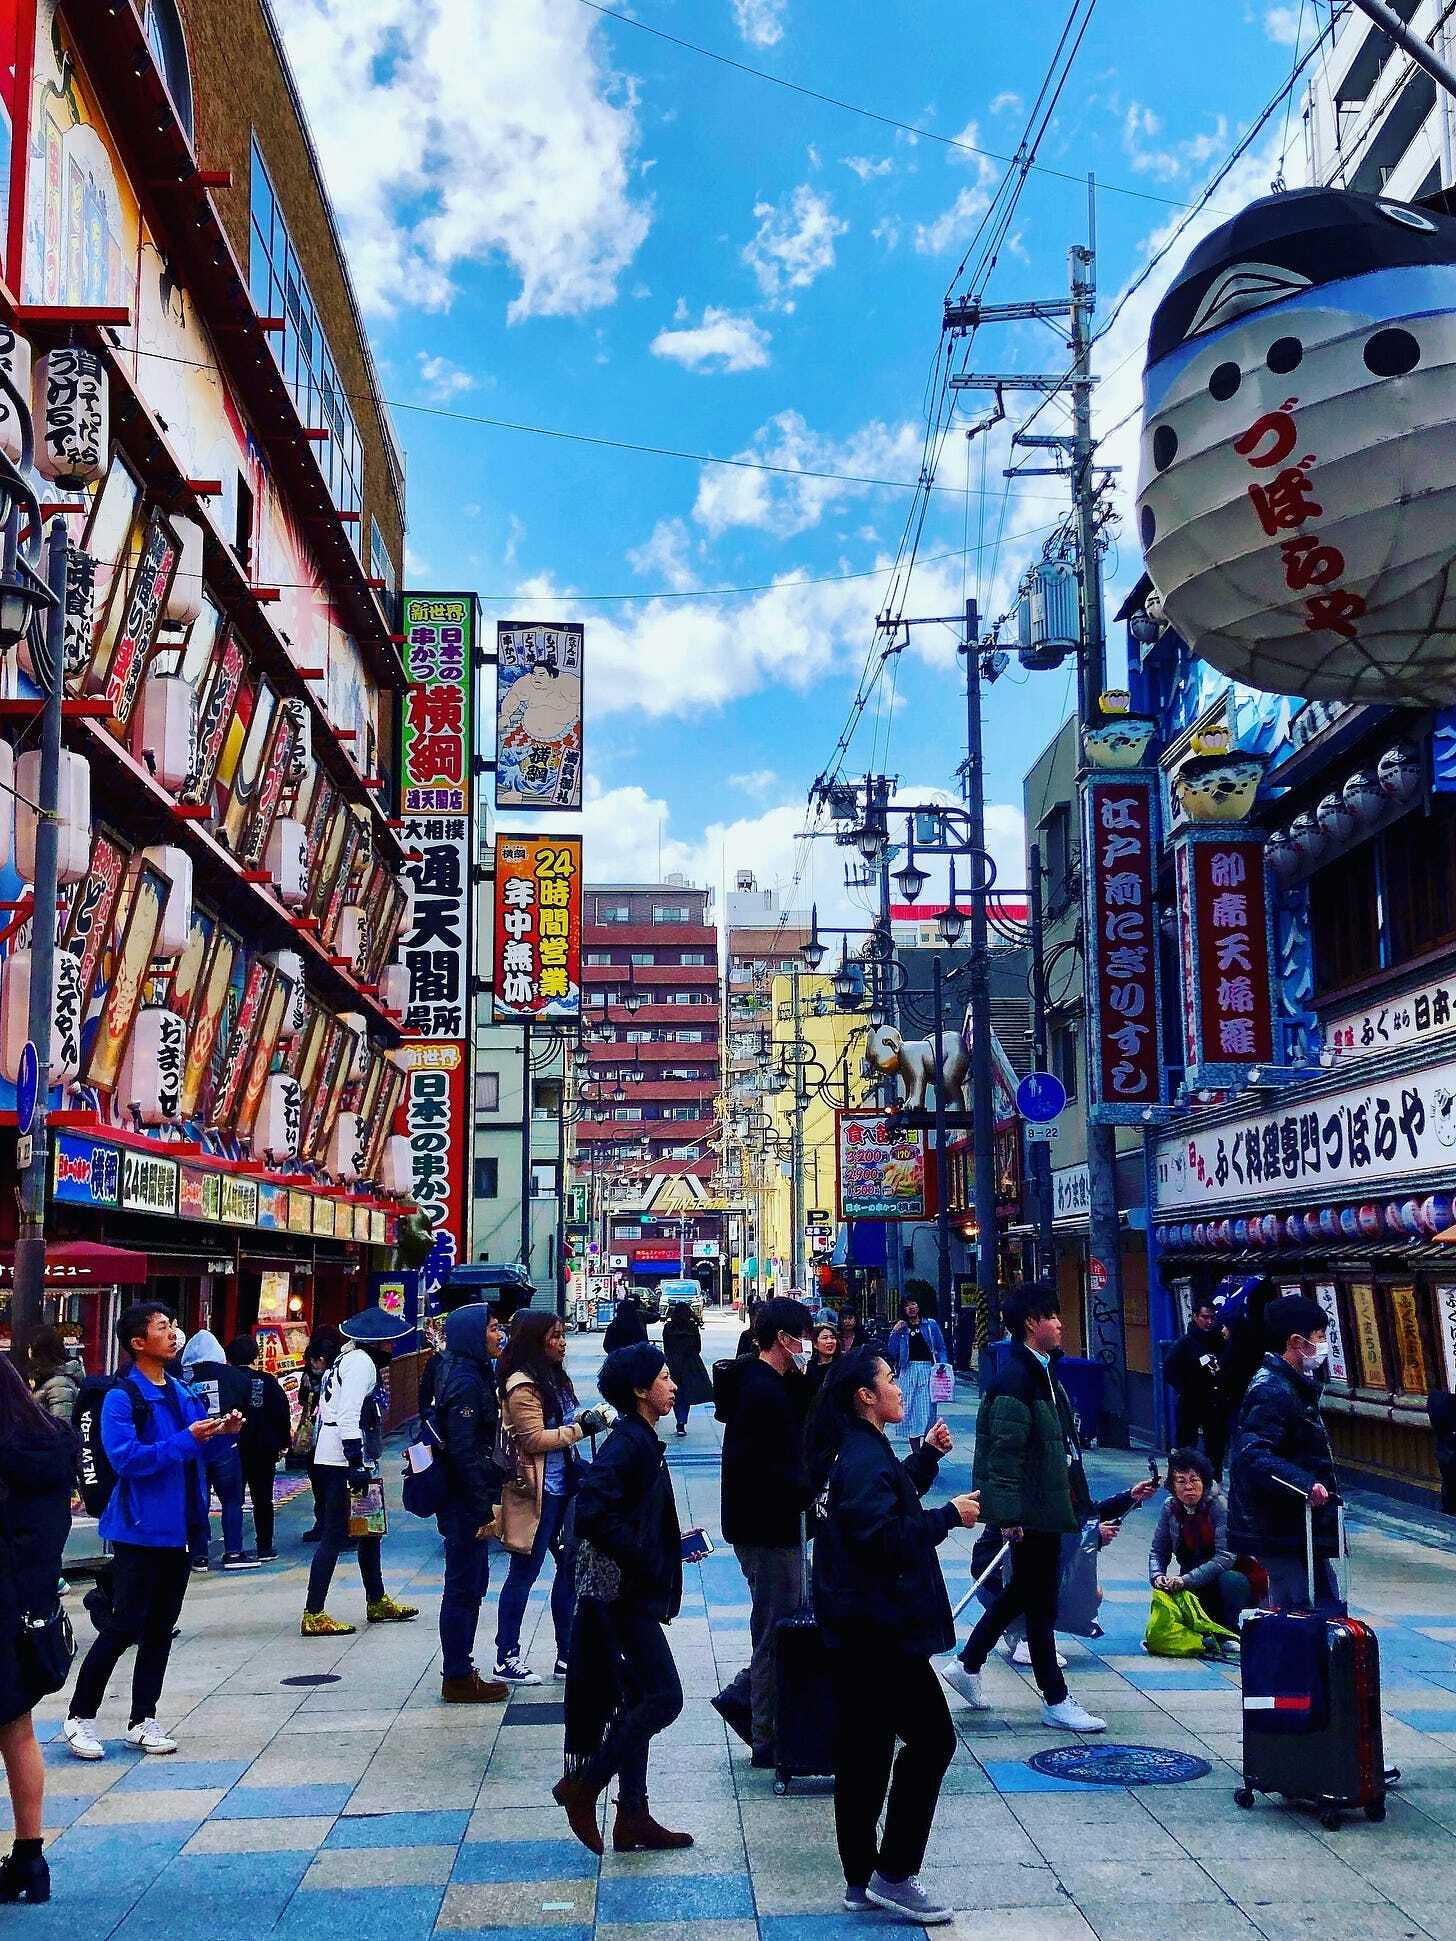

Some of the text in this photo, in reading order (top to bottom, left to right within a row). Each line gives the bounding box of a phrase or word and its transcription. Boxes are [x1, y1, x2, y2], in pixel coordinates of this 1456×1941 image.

[1234, 398, 1367, 637] づぼらや
[410, 602, 465, 622] 新世界
[409, 627, 437, 681] 串かつ
[438, 627, 464, 682] 日本一の
[407, 684, 464, 784] 横綱
[406, 788, 463, 811] 通天閣店
[404, 819, 465, 841] 大相撲
[401, 845, 464, 1003] 通天閣
[504, 878, 535, 1004] 年中無休
[536, 848, 575, 997] 24時間営業
[1101, 798, 1149, 1094] 江戸前にぎりすし
[402, 1005, 463, 1037] 場所
[807, 1210, 830, 1226] P
